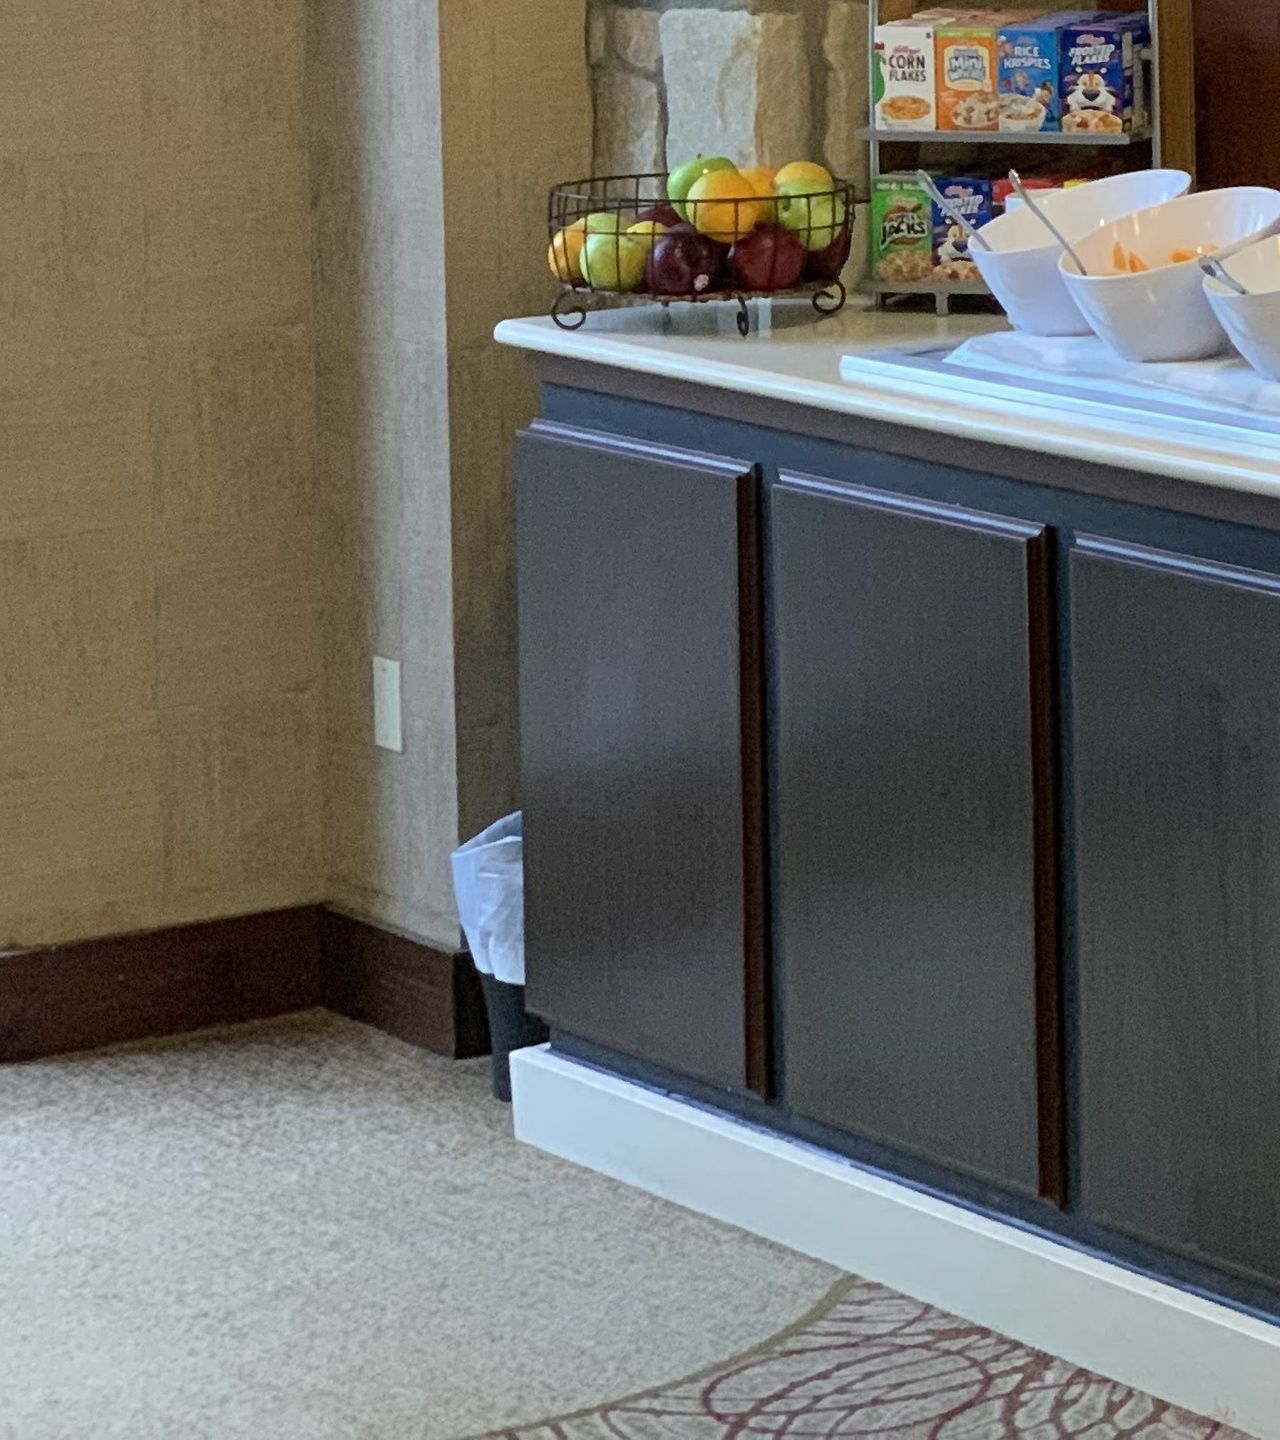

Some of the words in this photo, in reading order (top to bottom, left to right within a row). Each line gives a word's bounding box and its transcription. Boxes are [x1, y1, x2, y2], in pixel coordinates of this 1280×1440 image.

[1014, 46, 1040, 57] RICE
[888, 54, 926, 69] CORN
[889, 69, 927, 82] FLAKES
